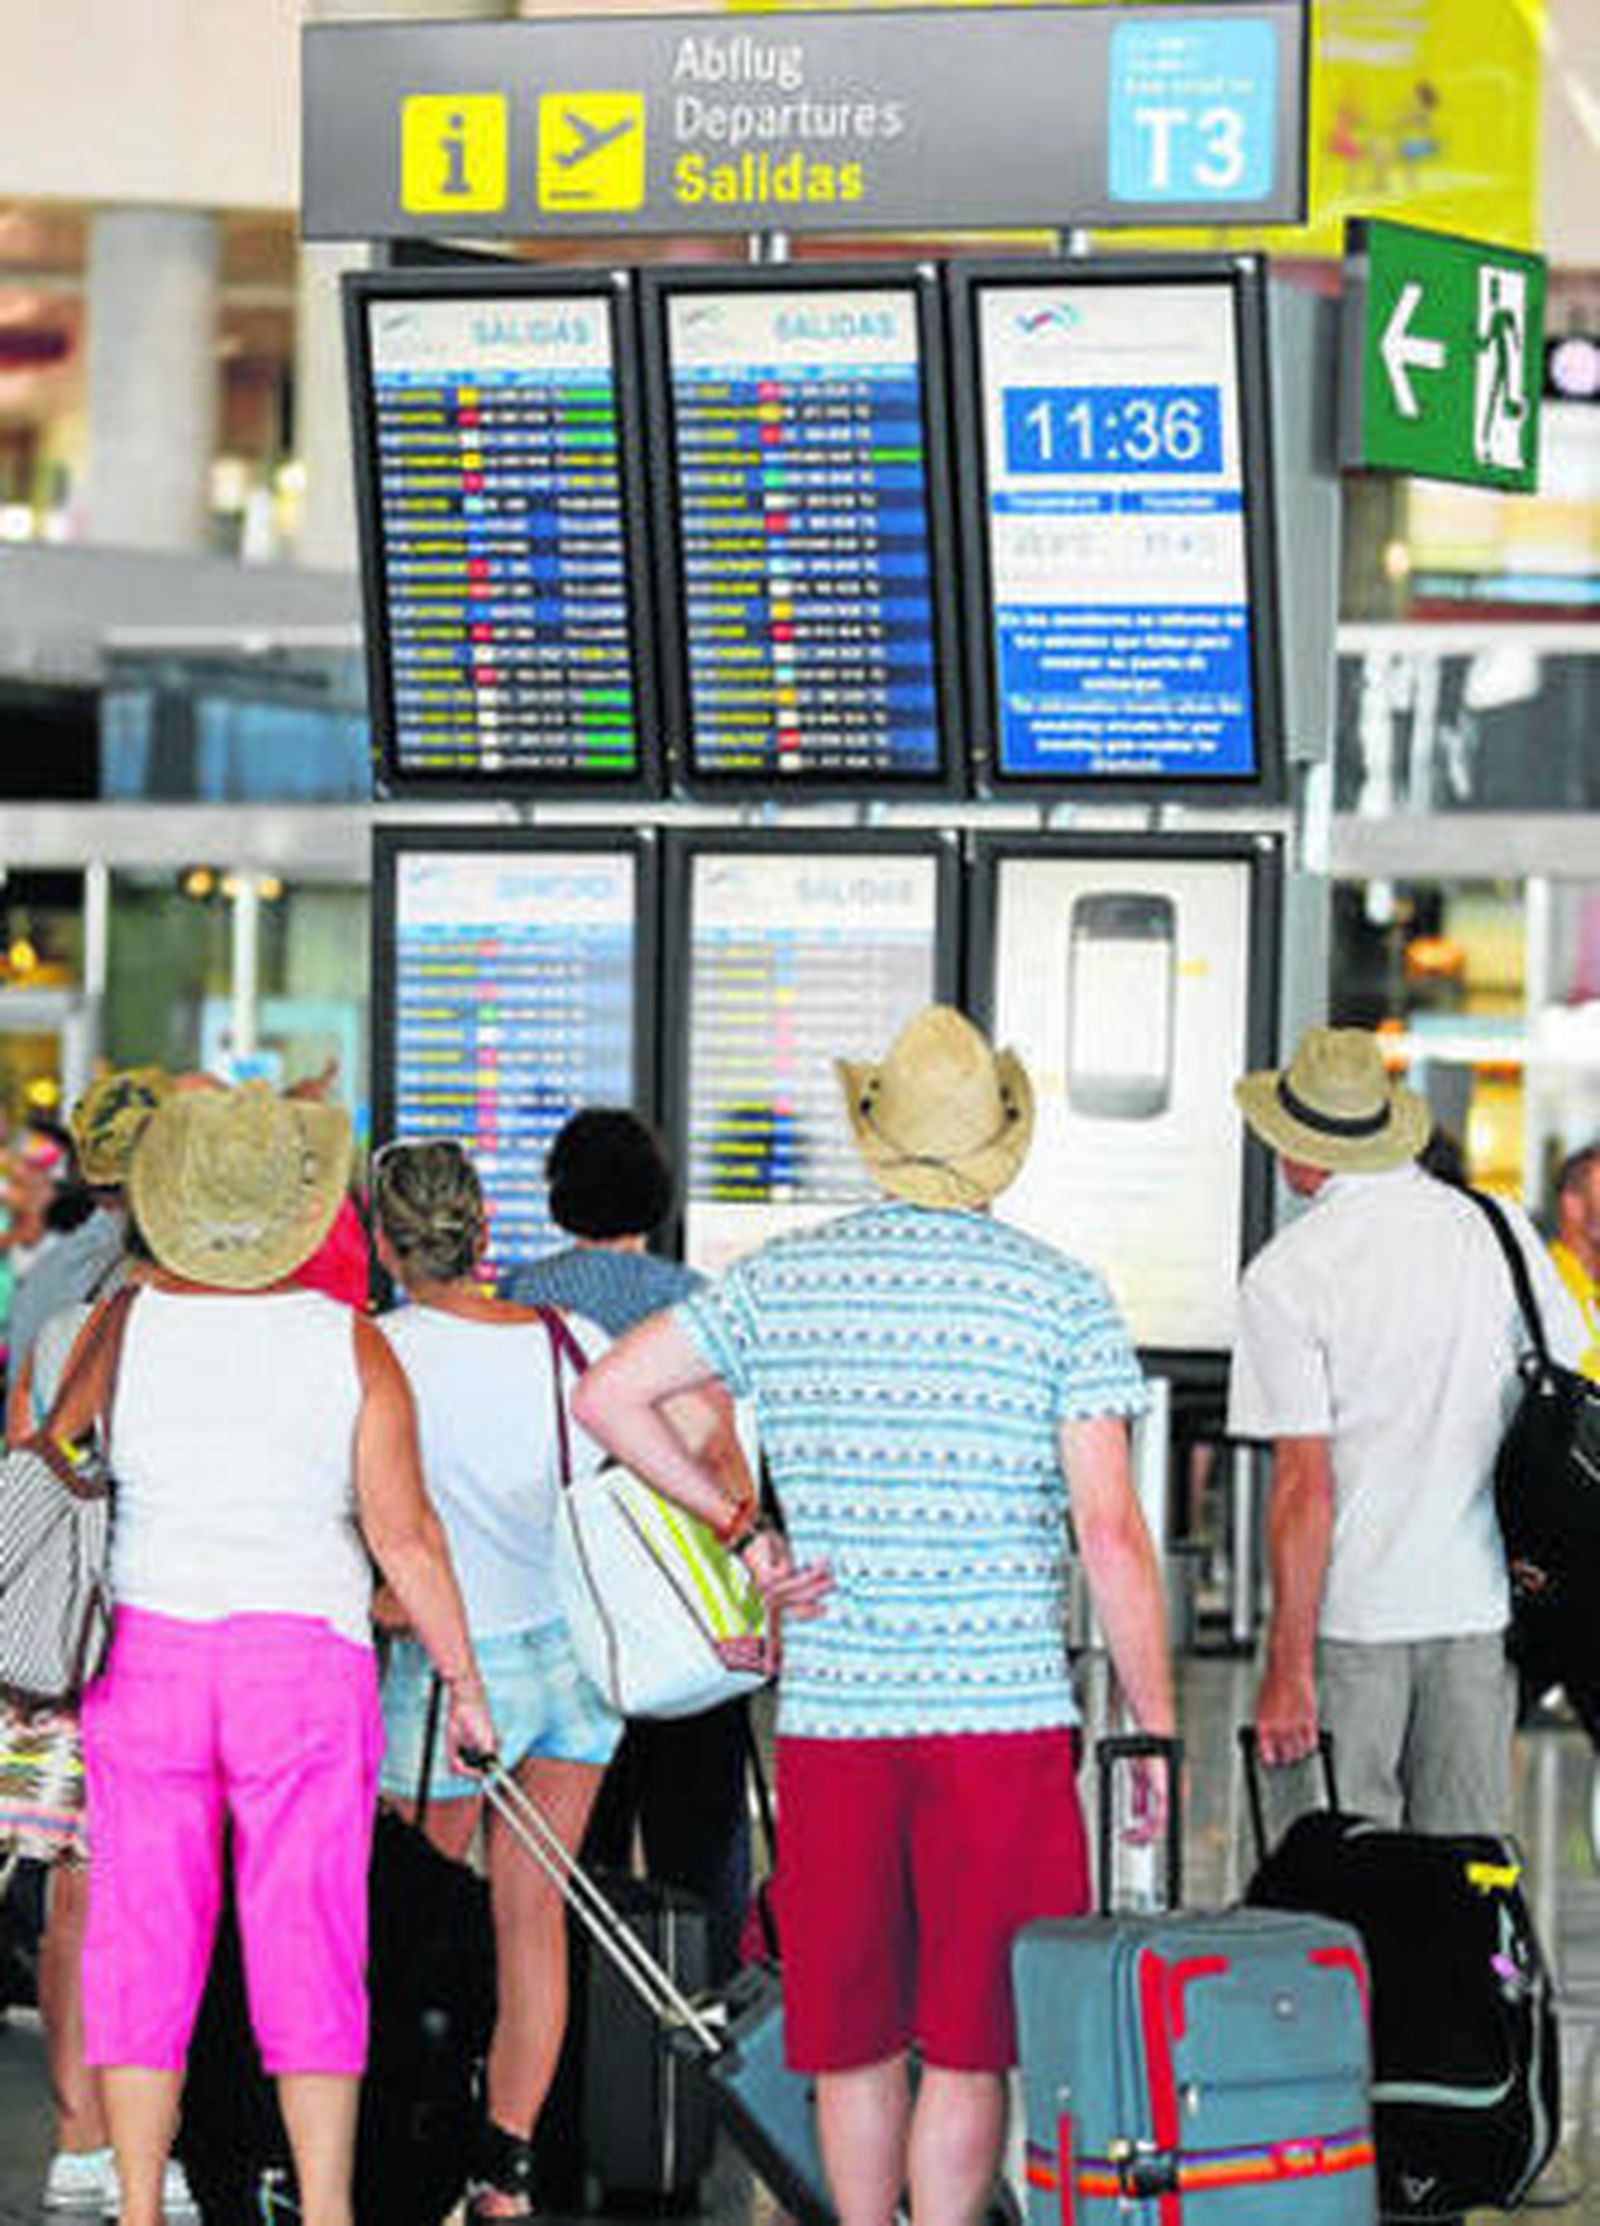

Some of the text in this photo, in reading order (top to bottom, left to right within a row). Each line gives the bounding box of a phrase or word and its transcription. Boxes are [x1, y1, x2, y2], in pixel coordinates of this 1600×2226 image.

[672, 36, 804, 88] Abflug
[673, 96, 905, 146] Departures
[1133, 107, 1245, 192] T3
[672, 152, 865, 204] Salidas
[1024, 398, 1203, 461] 11:36
